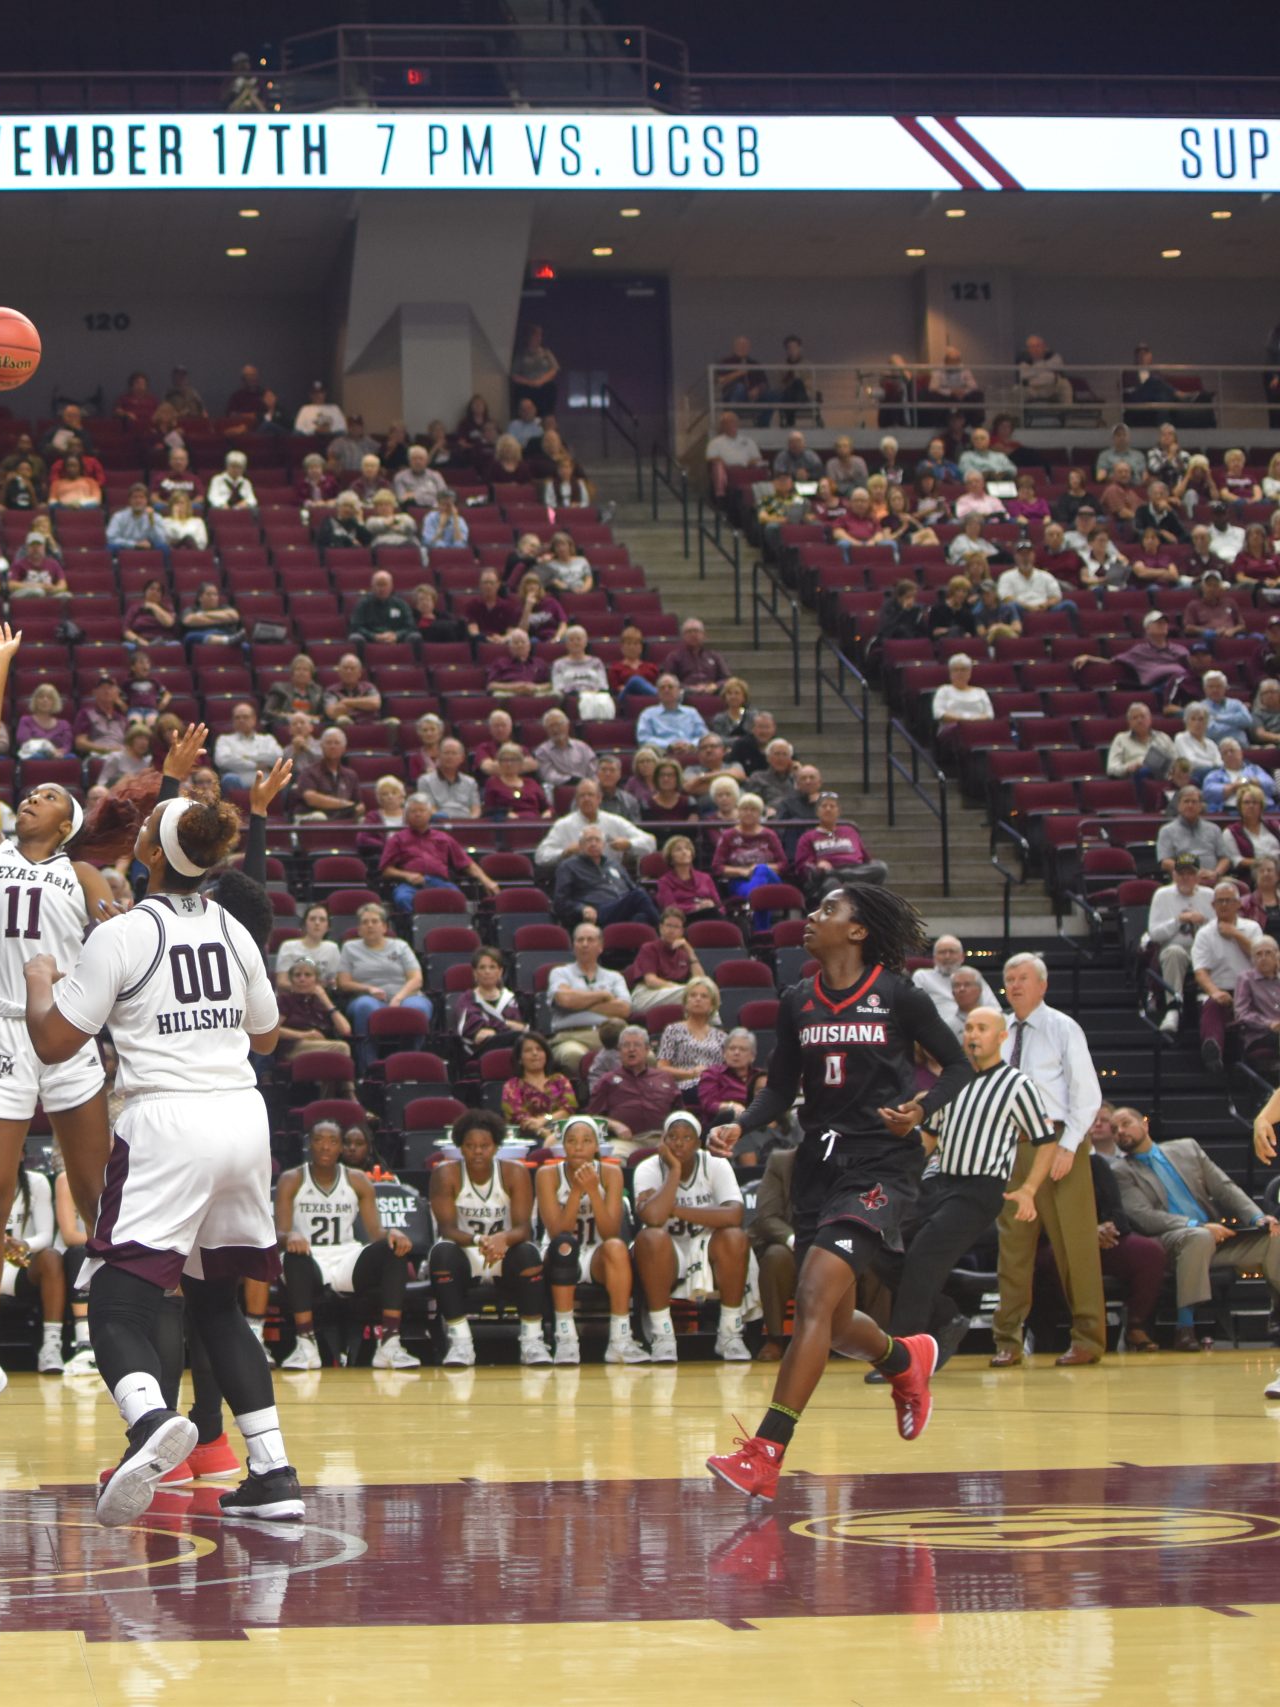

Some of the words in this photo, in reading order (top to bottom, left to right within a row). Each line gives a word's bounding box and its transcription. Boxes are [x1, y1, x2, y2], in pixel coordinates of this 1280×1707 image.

[212, 124, 328, 175] 17TH
[376, 124, 395, 176] 7
[428, 124, 493, 176] PM
[525, 124, 601, 177] VS.
[632, 125, 759, 177] UCSB
[1180, 127, 1270, 180] SUP
[950, 281, 992, 301] 121
[84, 312, 131, 332] 120
[43, 871, 76, 897] A&M
[4, 885, 42, 940] 11
[169, 941, 232, 1005] 00
[800, 1024, 886, 1046] OUISIANA
[824, 1054, 844, 1086] 0
[299, 1202, 333, 1214] TEXAS
[376, 1196, 417, 1213] SCLE
[458, 1206, 492, 1218] TEXAS
[310, 1216, 341, 1246] 21
[380, 1213, 408, 1228] ILK
